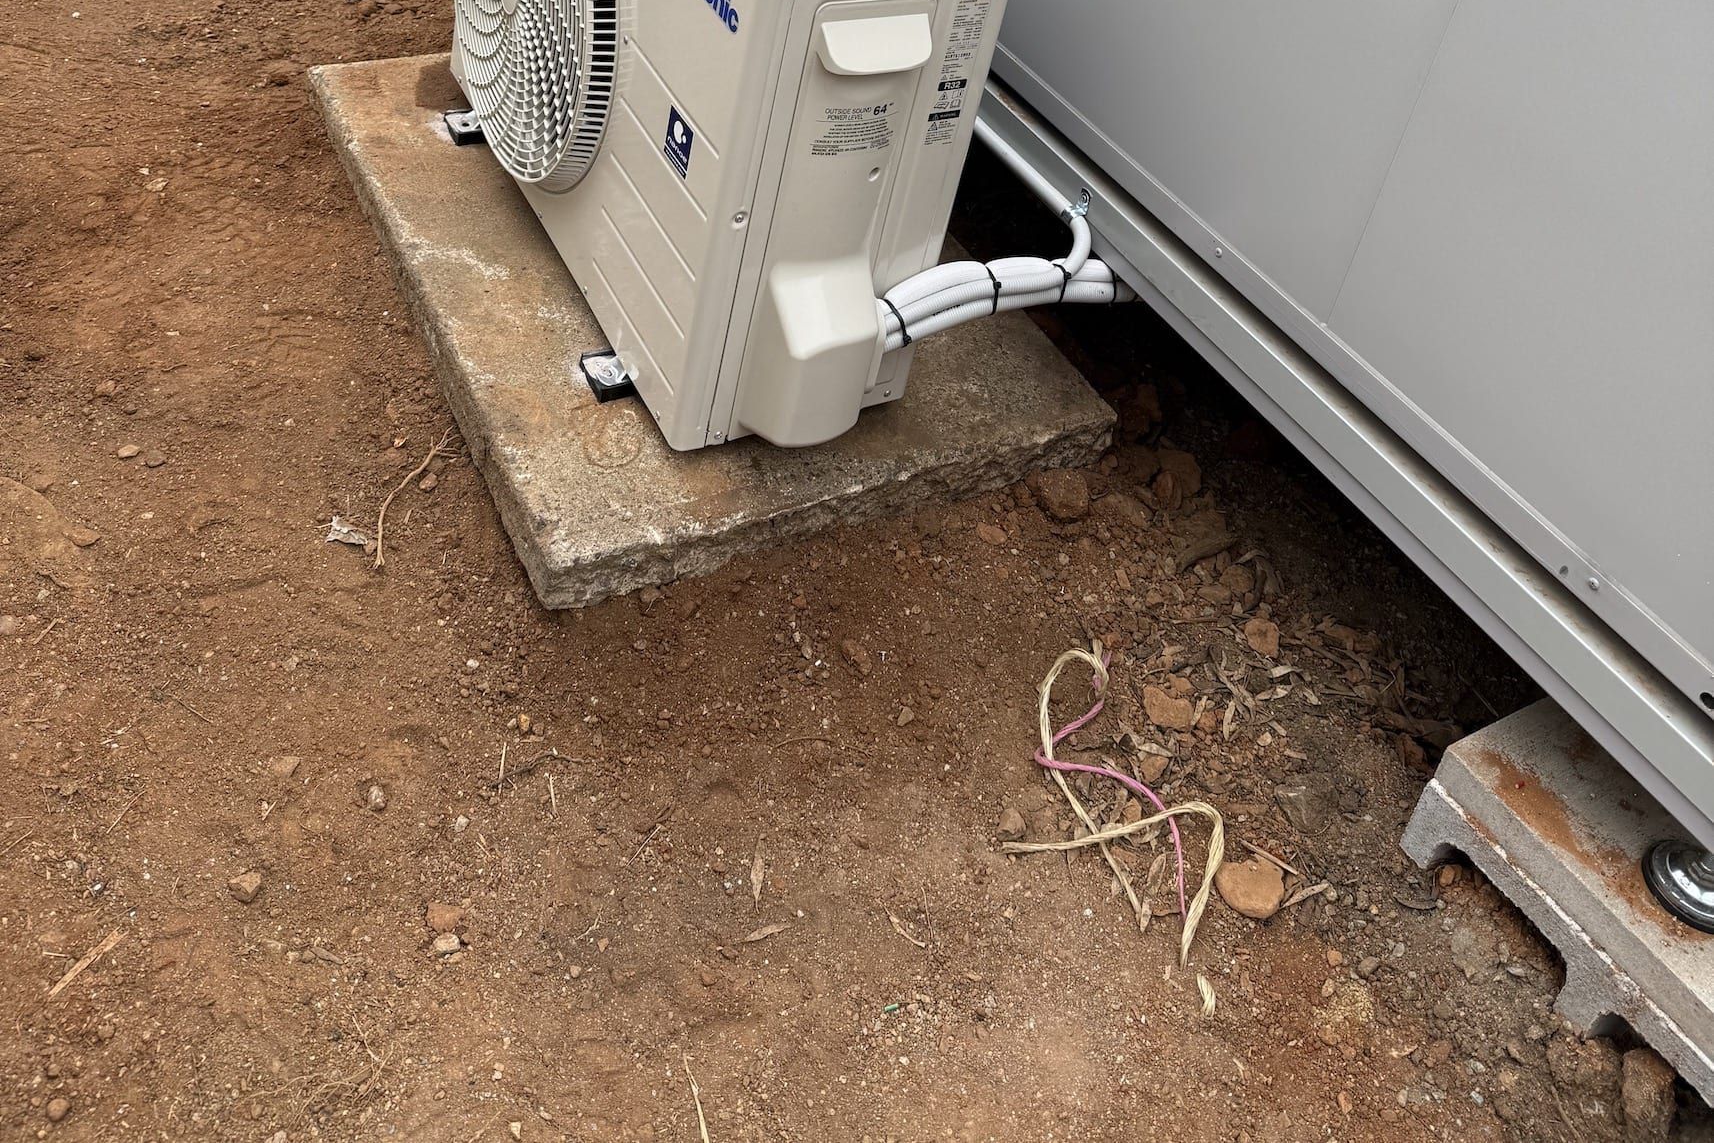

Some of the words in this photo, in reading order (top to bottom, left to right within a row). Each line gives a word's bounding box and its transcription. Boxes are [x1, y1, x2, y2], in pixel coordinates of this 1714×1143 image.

[943, 81, 961, 90] R32
[825, 107, 852, 115] OUTSIDE
[852, 106, 871, 114] SOUND
[873, 104, 887, 116] 64
